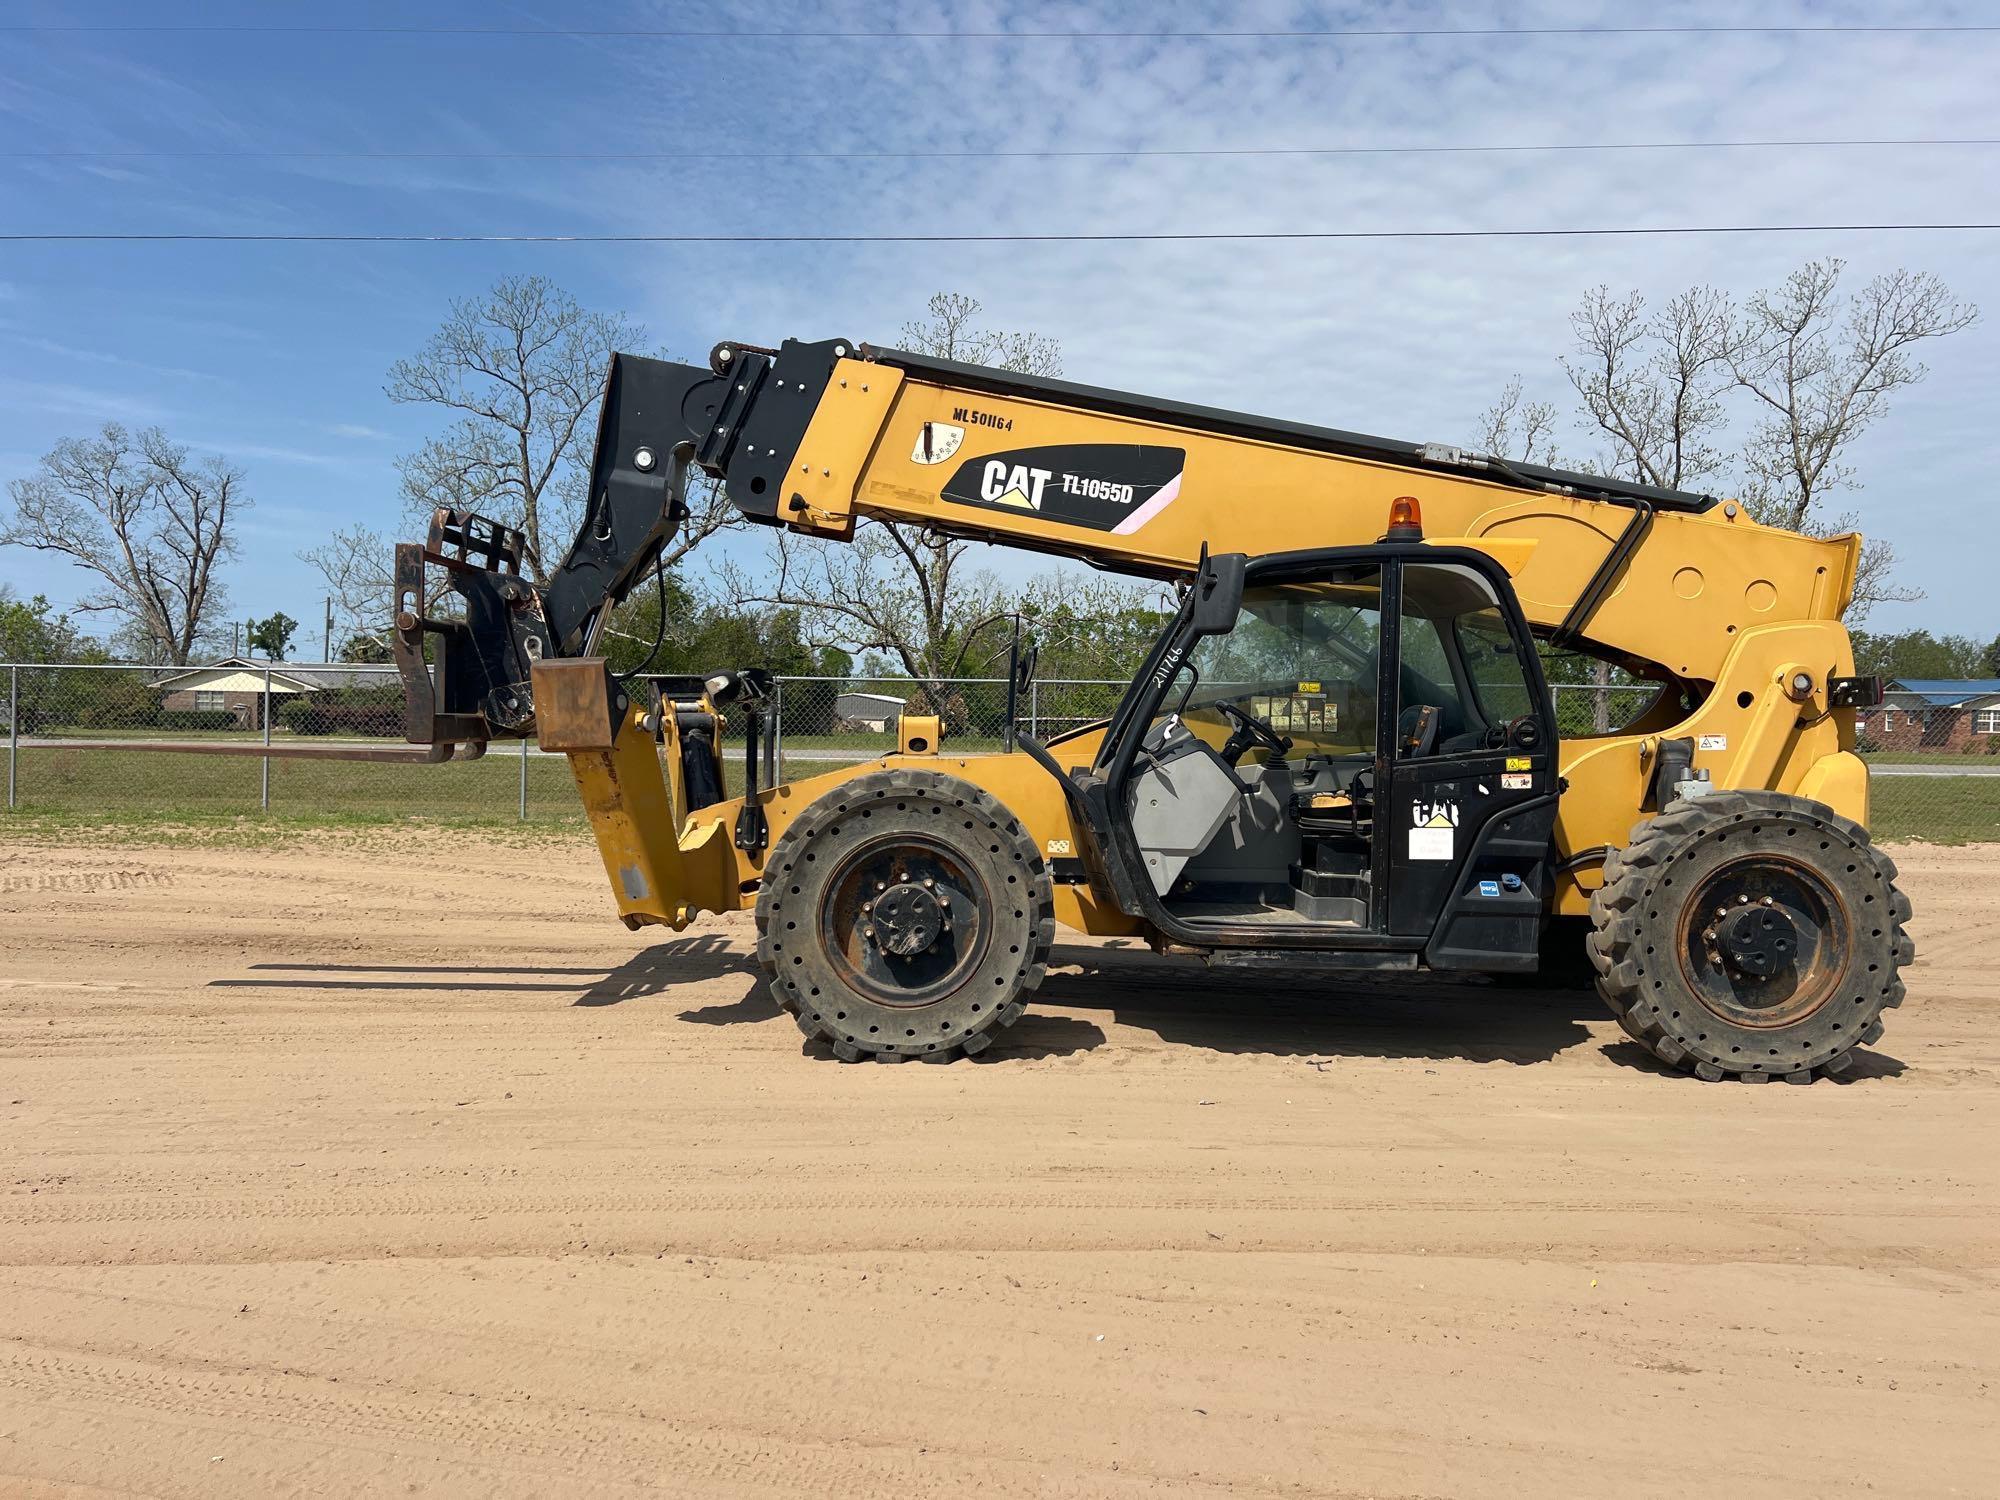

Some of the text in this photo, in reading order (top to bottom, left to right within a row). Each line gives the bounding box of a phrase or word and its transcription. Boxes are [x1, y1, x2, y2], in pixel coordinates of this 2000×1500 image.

[980, 460, 1052, 511] CAT
[1062, 473, 1134, 504] TL1055D
[1152, 647, 1183, 689] 211766
